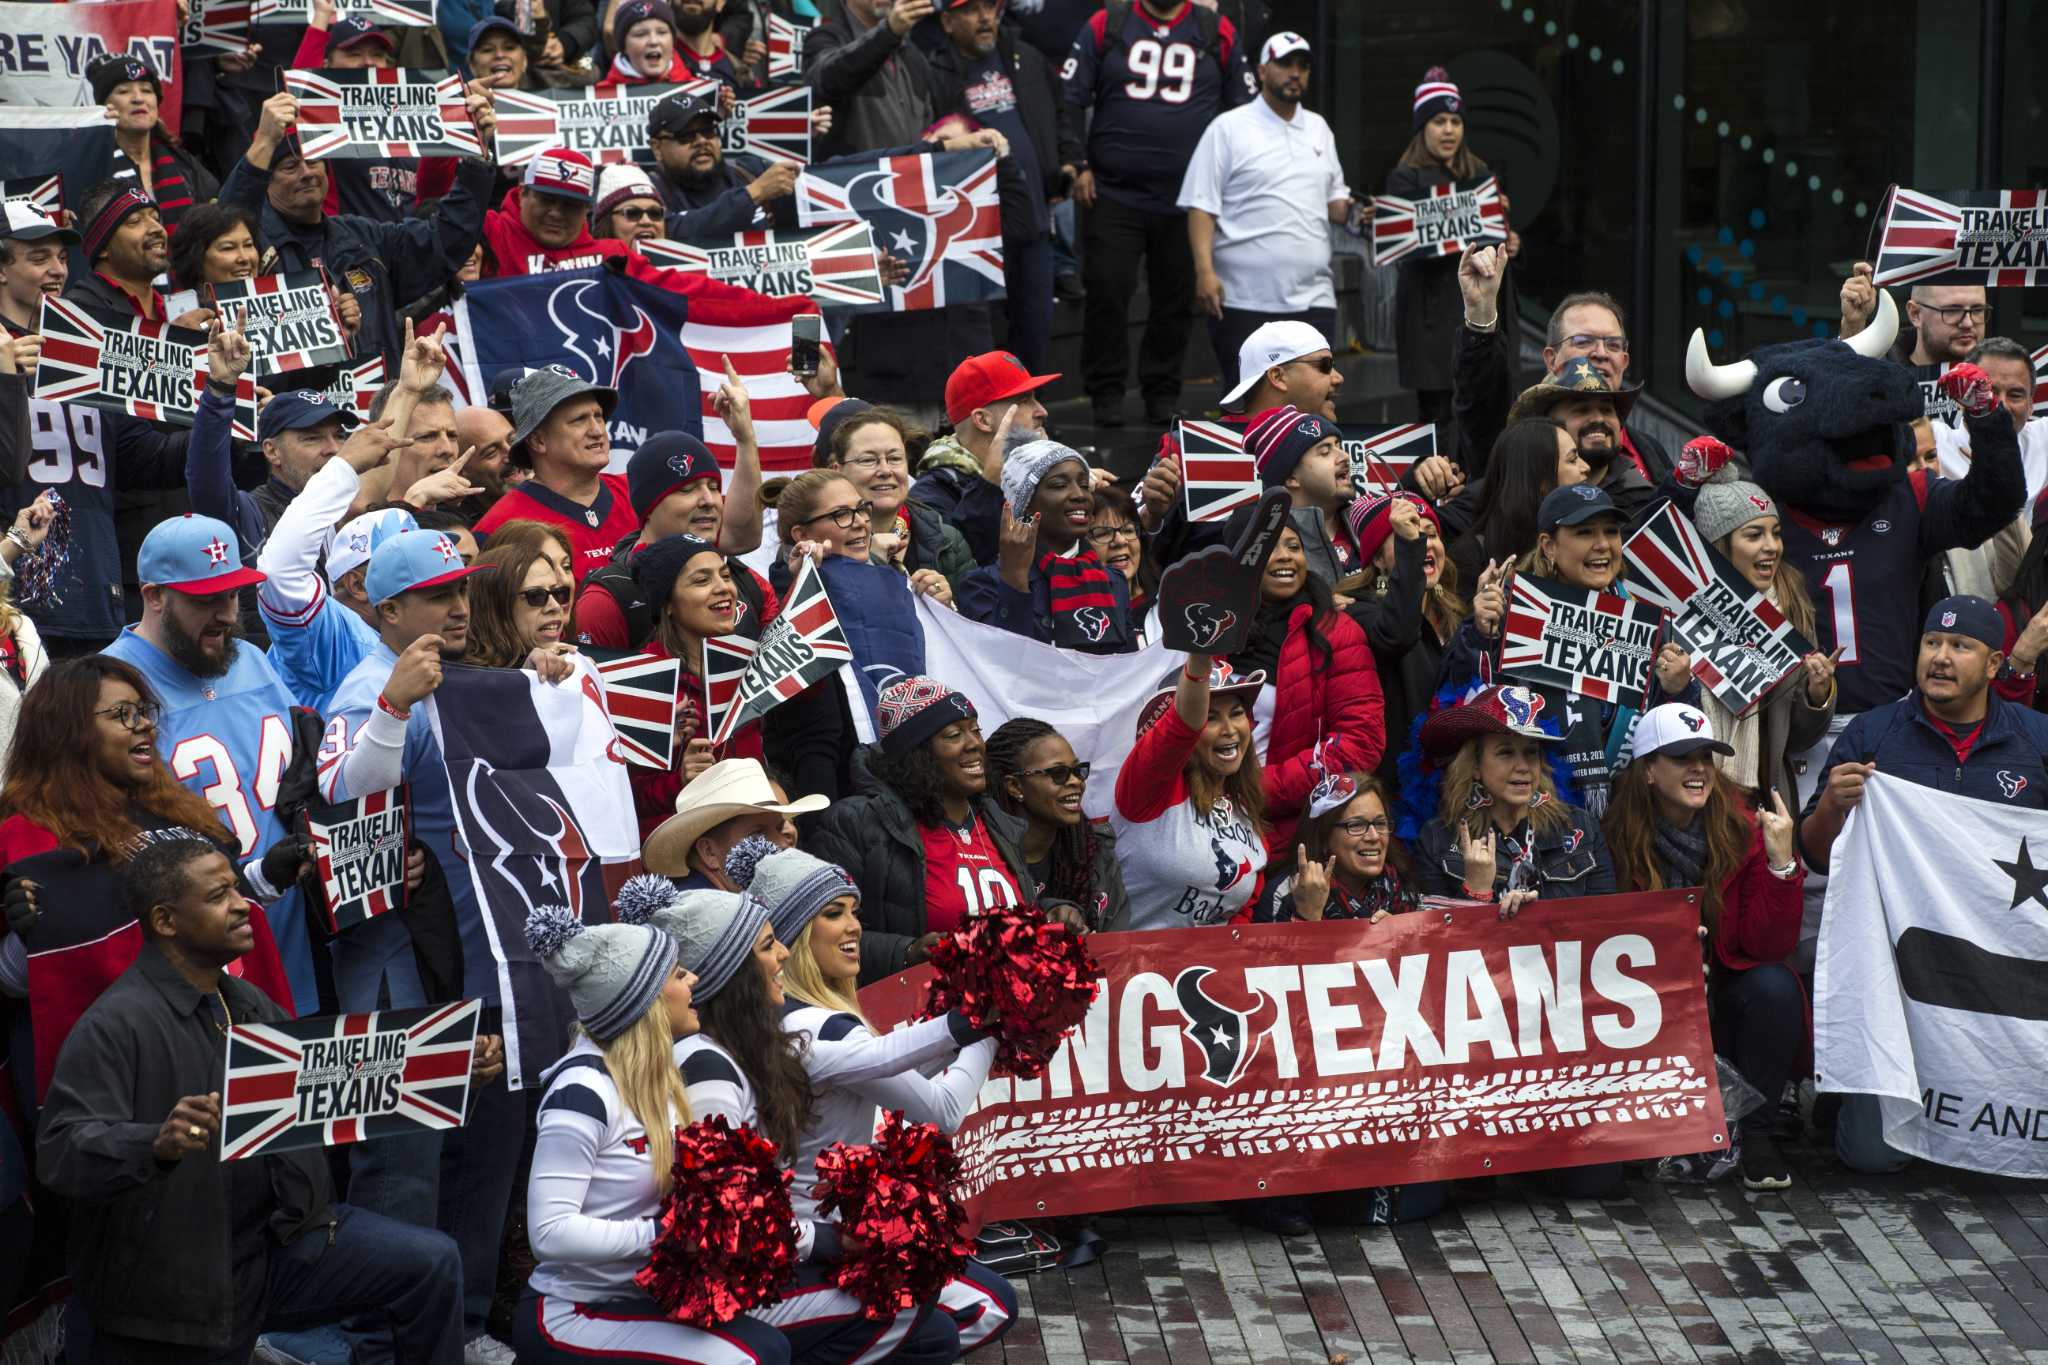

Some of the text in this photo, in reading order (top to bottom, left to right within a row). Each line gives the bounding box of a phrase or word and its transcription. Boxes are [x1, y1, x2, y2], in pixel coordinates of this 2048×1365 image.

[1125, 39, 1196, 103] 99
[340, 87, 437, 106] TRAVELING
[342, 114, 445, 142] TEXANS
[559, 123, 651, 149] TEXAN
[1414, 194, 1477, 217] TRAVELING
[1416, 214, 1483, 244] TEXANS
[707, 244, 808, 268] TRAVELING
[103, 329, 193, 369] TRAVELING
[244, 316, 337, 355] EXANS
[100, 362, 193, 409] TEXANS
[28, 401, 106, 488] 99
[584, 545, 614, 559] TEXA
[1811, 550, 1855, 560] TEXANS
[1821, 560, 1858, 664] 1
[957, 866, 1019, 916] 10
[1245, 934, 1662, 1078] TEXANS
[301, 1032, 407, 1070] TRAVELING
[296, 1075, 401, 1123] TEXANS
